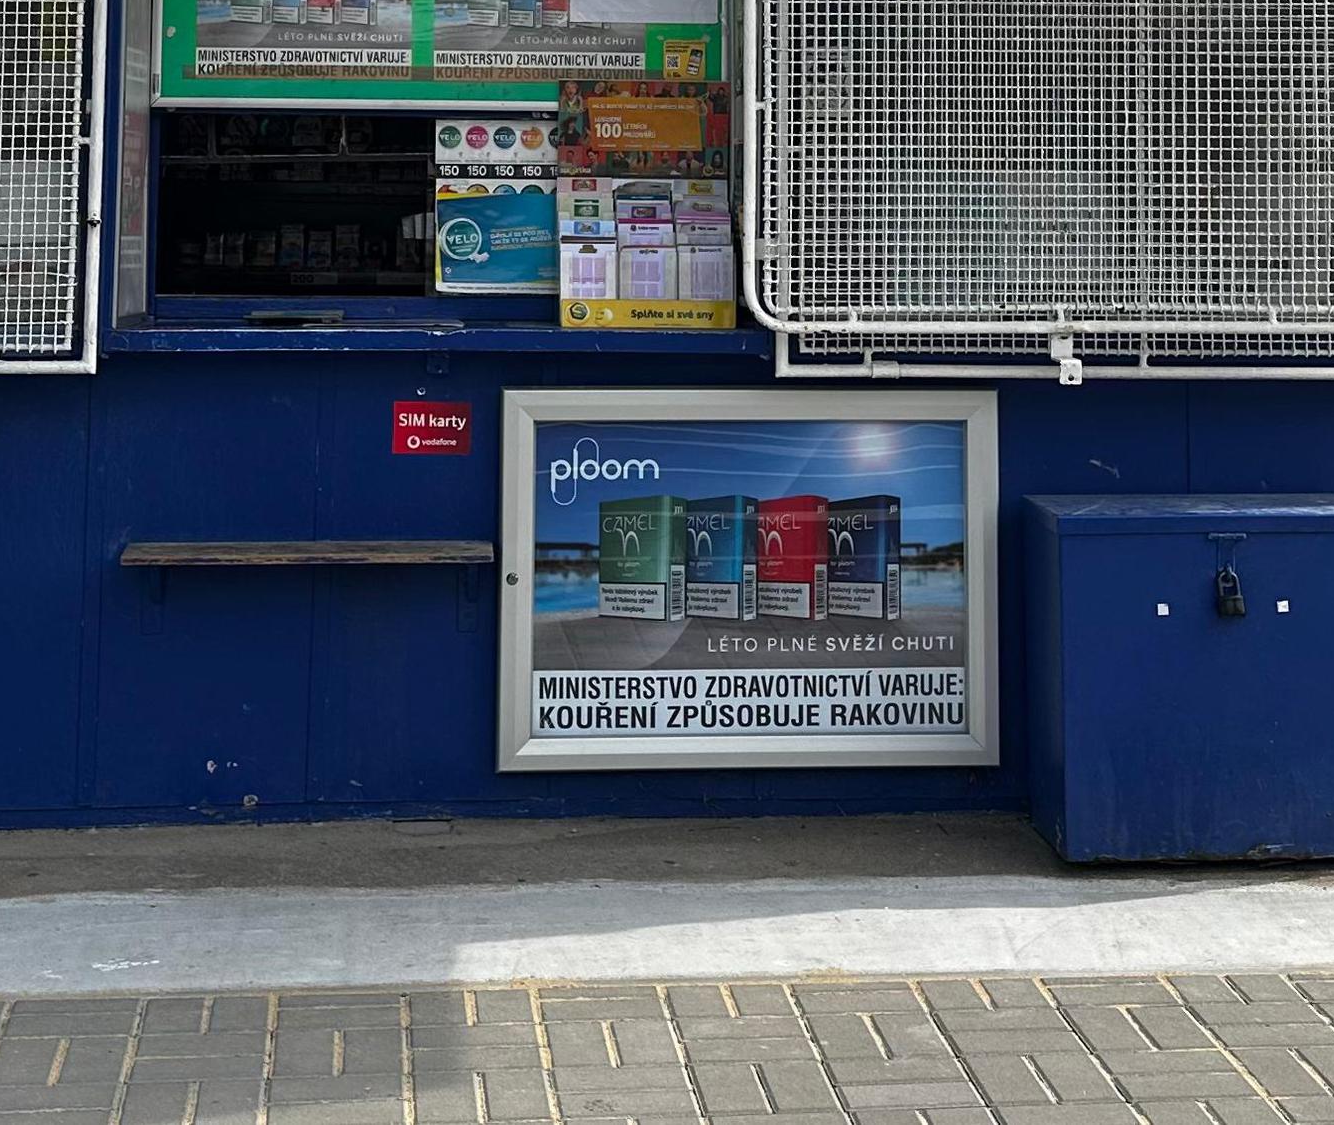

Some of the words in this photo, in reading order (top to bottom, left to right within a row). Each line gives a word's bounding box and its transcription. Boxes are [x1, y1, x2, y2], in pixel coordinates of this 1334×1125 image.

[370, 34, 403, 42] CHUTI
[604, 37, 636, 45] CHUTI
[198, 50, 277, 62] MINISTERSTVO
[280, 49, 363, 62] ZDRAVOTNICTVÍ
[436, 53, 513, 66] MINISTERSTVO
[517, 52, 599, 66] ZDRAVOTNICTVÍ
[595, 123, 621, 138] 100
[440, 166, 459, 175] 150
[467, 166, 487, 176] 150
[495, 166, 514, 176] 150
[522, 166, 542, 176] 150
[447, 235, 478, 244] VELO
[631, 309, 663, 320] Splňte
[697, 312, 714, 320] sny
[399, 413, 425, 427] SIM
[429, 414, 466, 431] karty
[422, 438, 457, 446] vodafone
[551, 437, 659, 505] ploom
[603, 514, 656, 532] CAMEL
[707, 635, 758, 653] LÉTO
[767, 635, 817, 652] PLNÉ
[826, 634, 884, 652] SVĚŽÍ
[892, 635, 955, 651] CHUTI
[539, 676, 697, 699] MINISTERSTVO
[704, 670, 872, 699] ZDRAVOTNICTVÍ
[877, 674, 964, 696] VARUJE:
[539, 702, 657, 729] KOUŘENÍ
[666, 699, 820, 728] ZPŮSOBUJE
[830, 701, 964, 726] RAKOVINU
